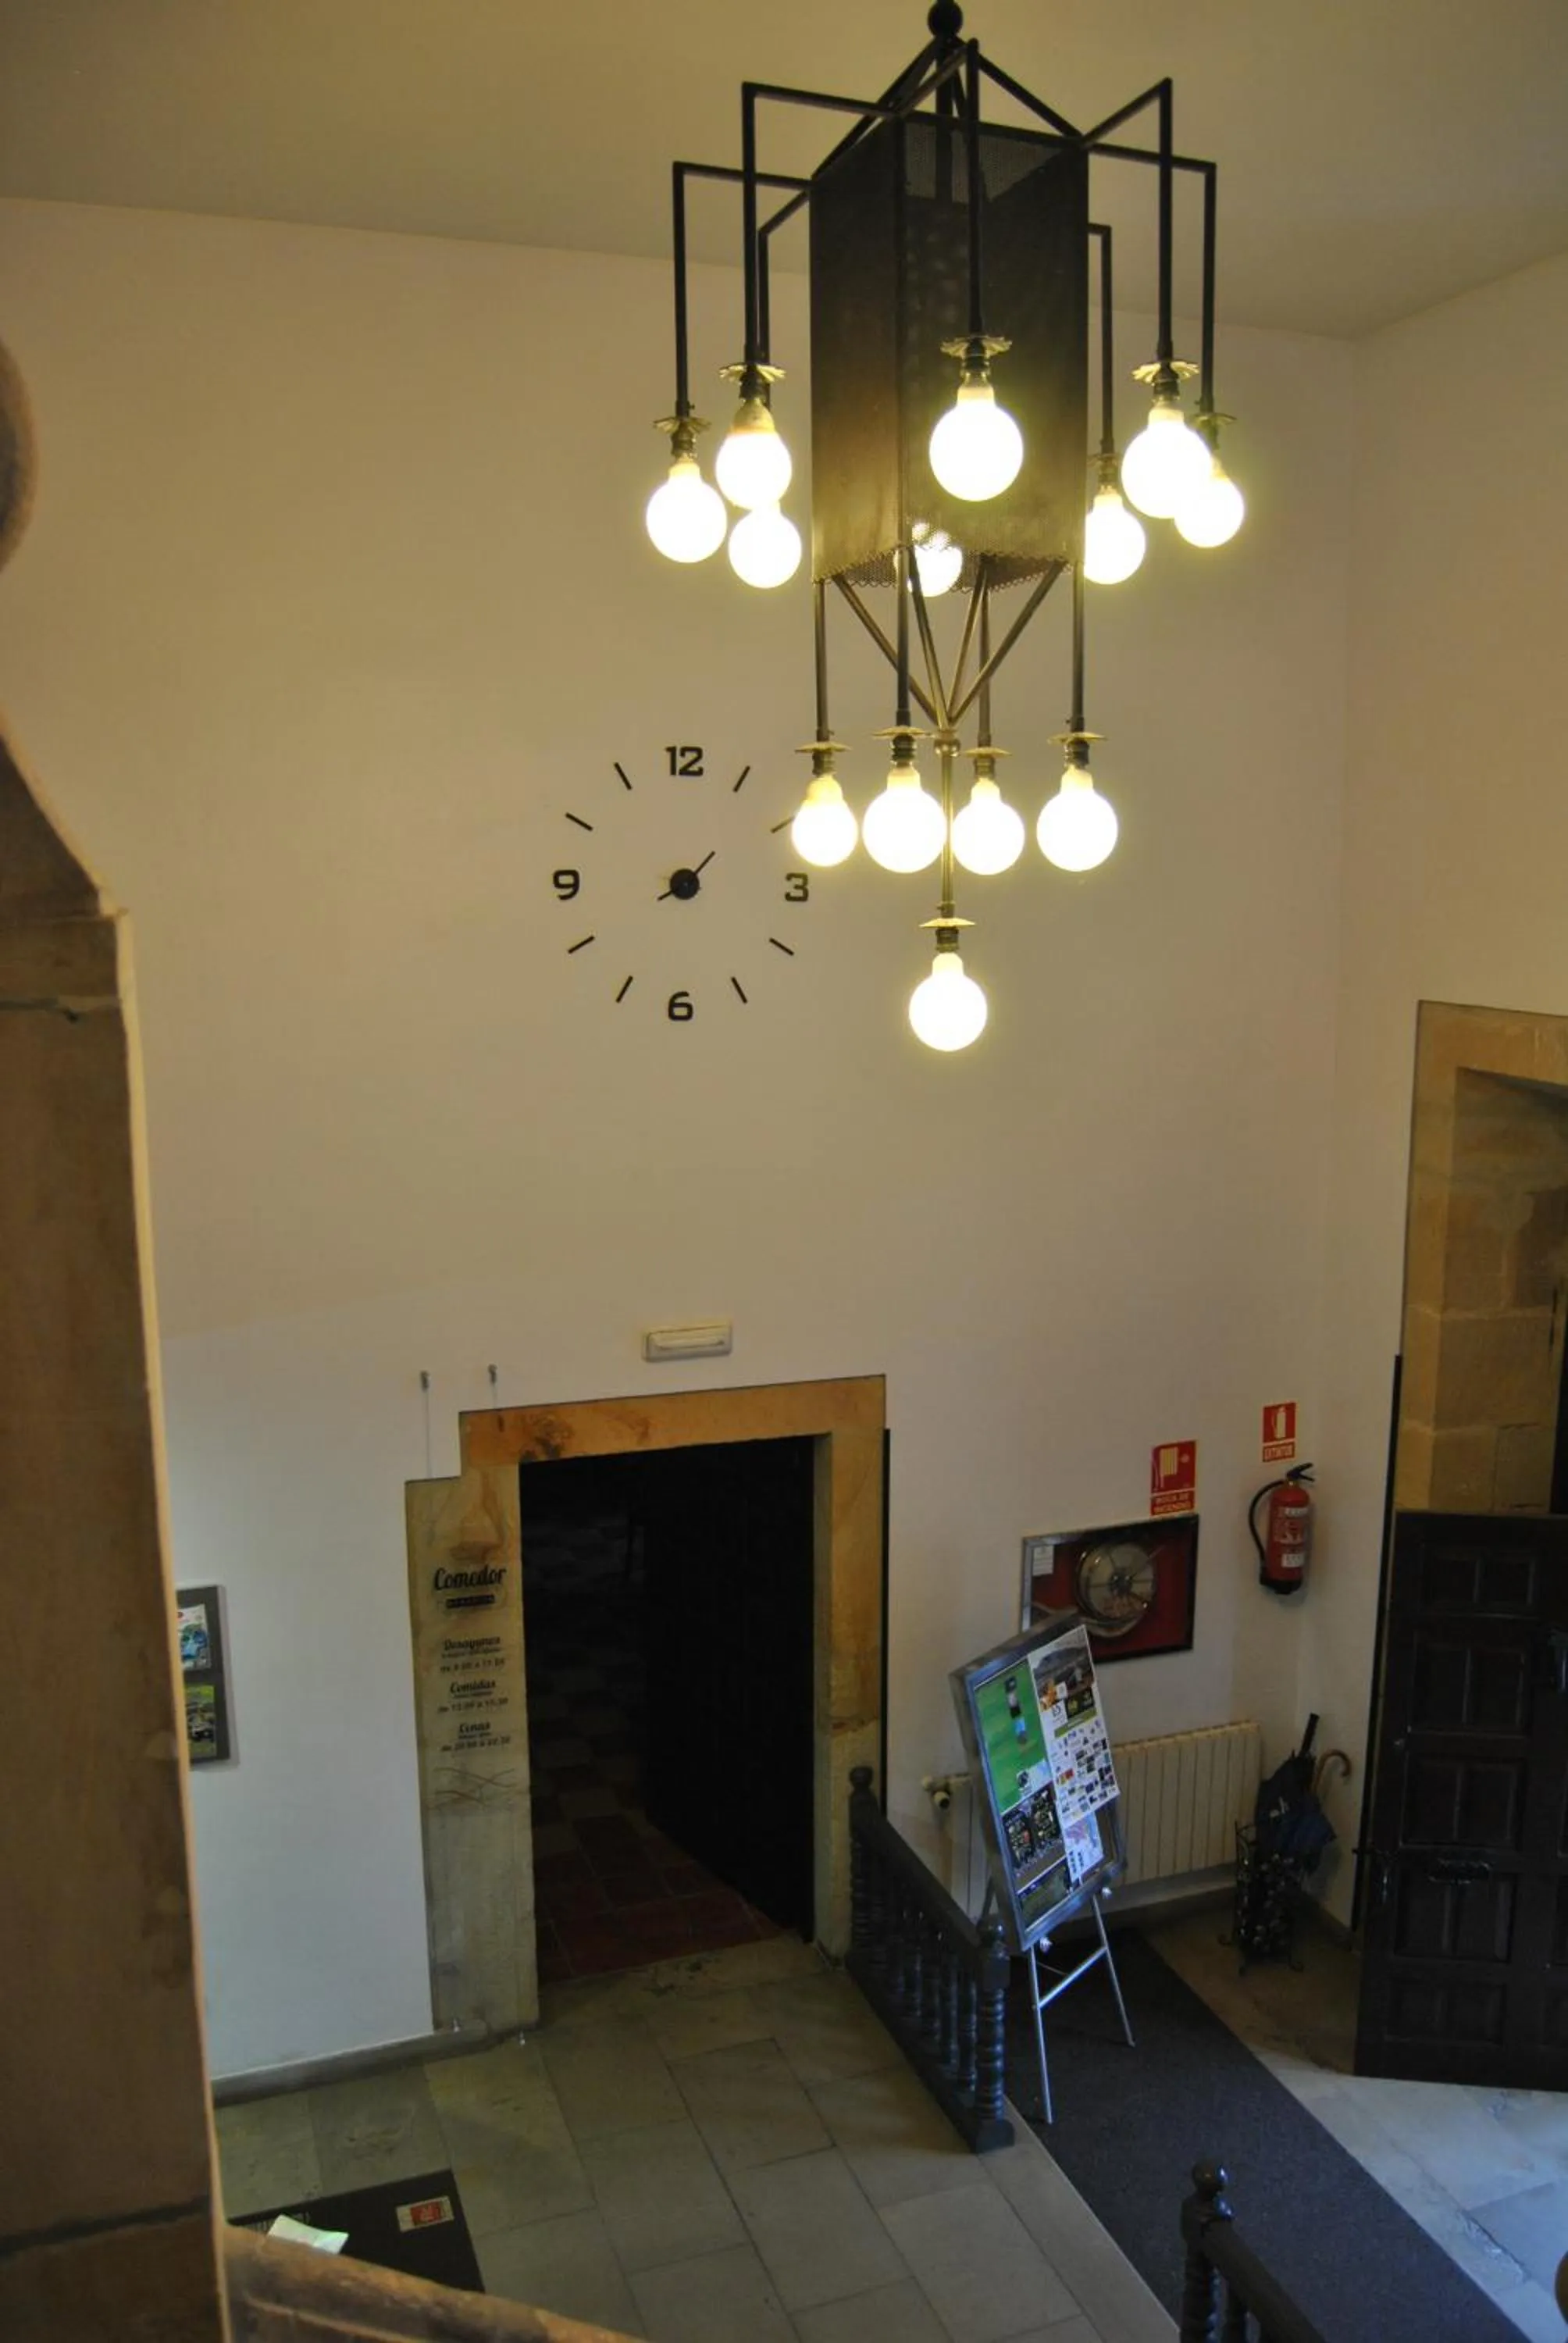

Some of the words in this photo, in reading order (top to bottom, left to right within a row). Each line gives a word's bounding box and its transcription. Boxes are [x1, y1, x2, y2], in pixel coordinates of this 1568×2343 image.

[665, 746, 704, 776] 12
[552, 869, 580, 900] 9
[784, 872, 809, 902] 3
[668, 991, 693, 1022] 6
[434, 1564, 507, 1591] Comedor
